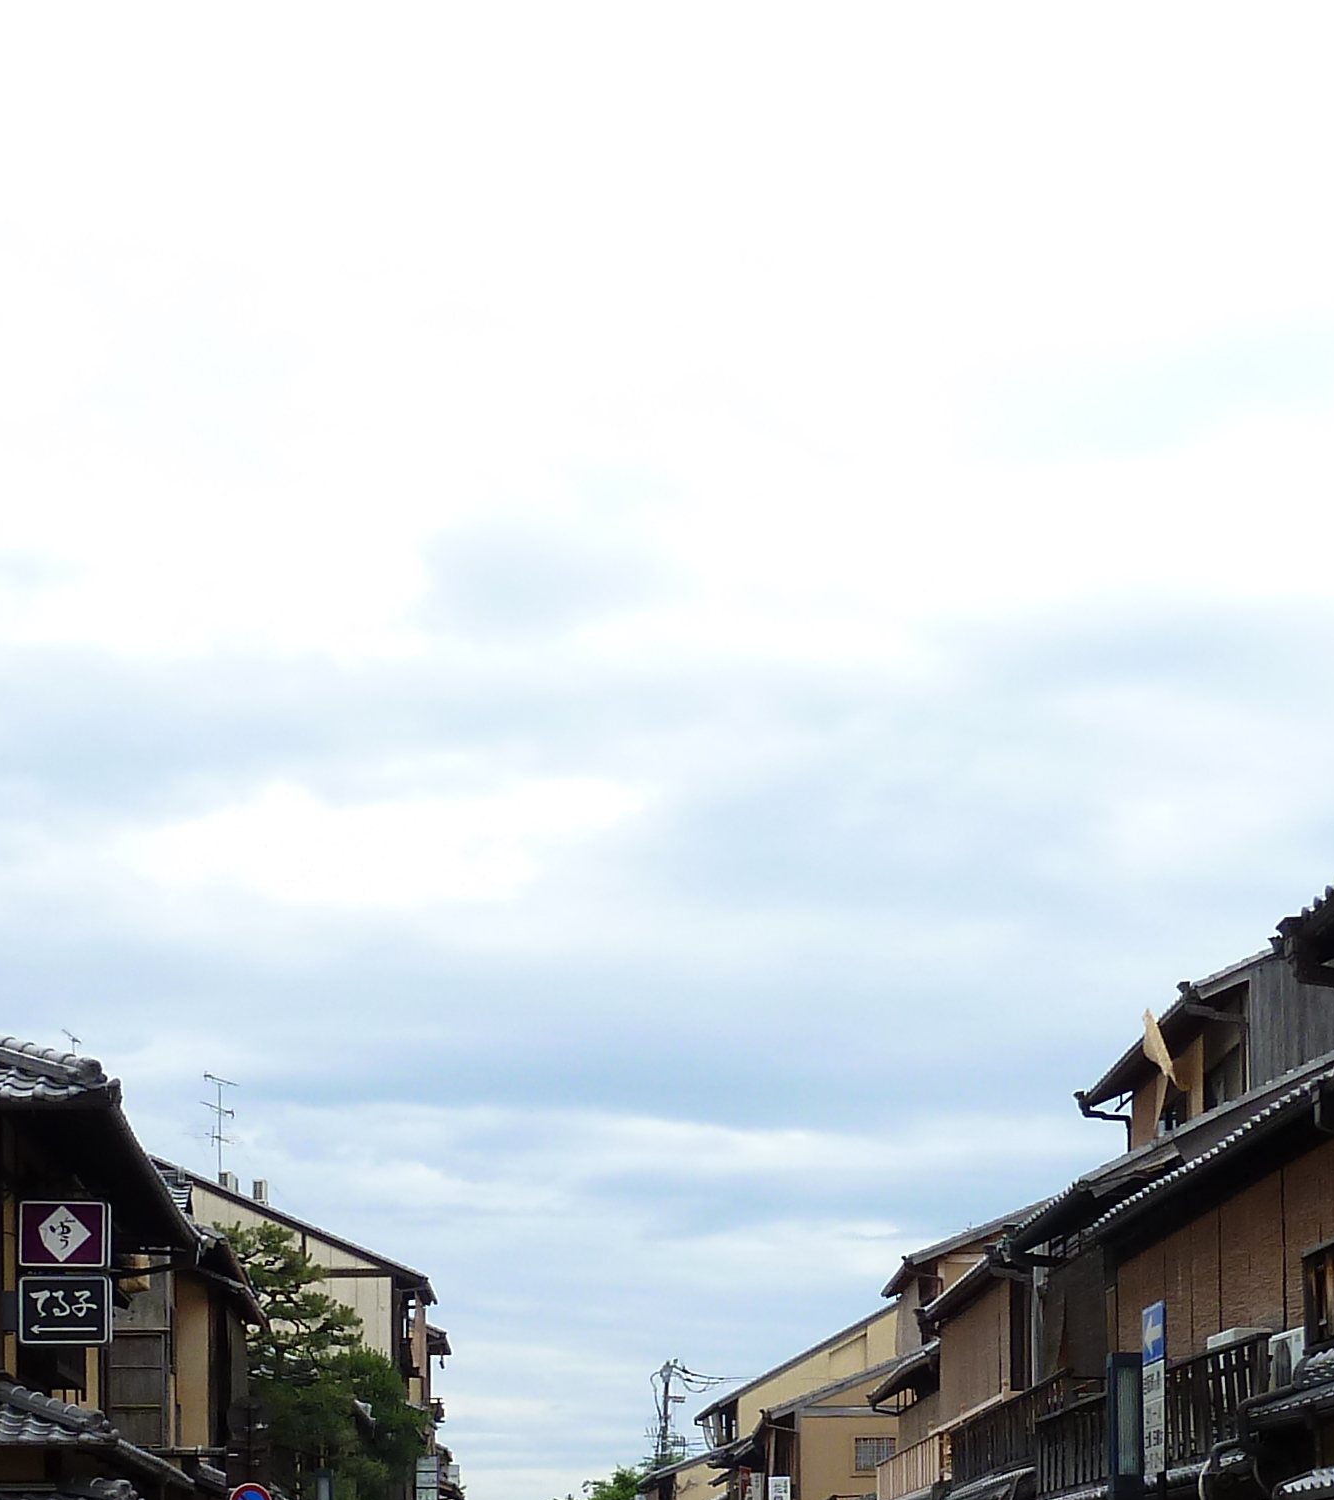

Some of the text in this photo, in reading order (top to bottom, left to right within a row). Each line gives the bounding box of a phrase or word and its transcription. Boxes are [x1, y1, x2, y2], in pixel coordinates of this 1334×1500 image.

[49, 1221, 71, 1250] ゆう
[29, 1289, 98, 1317] てる子
